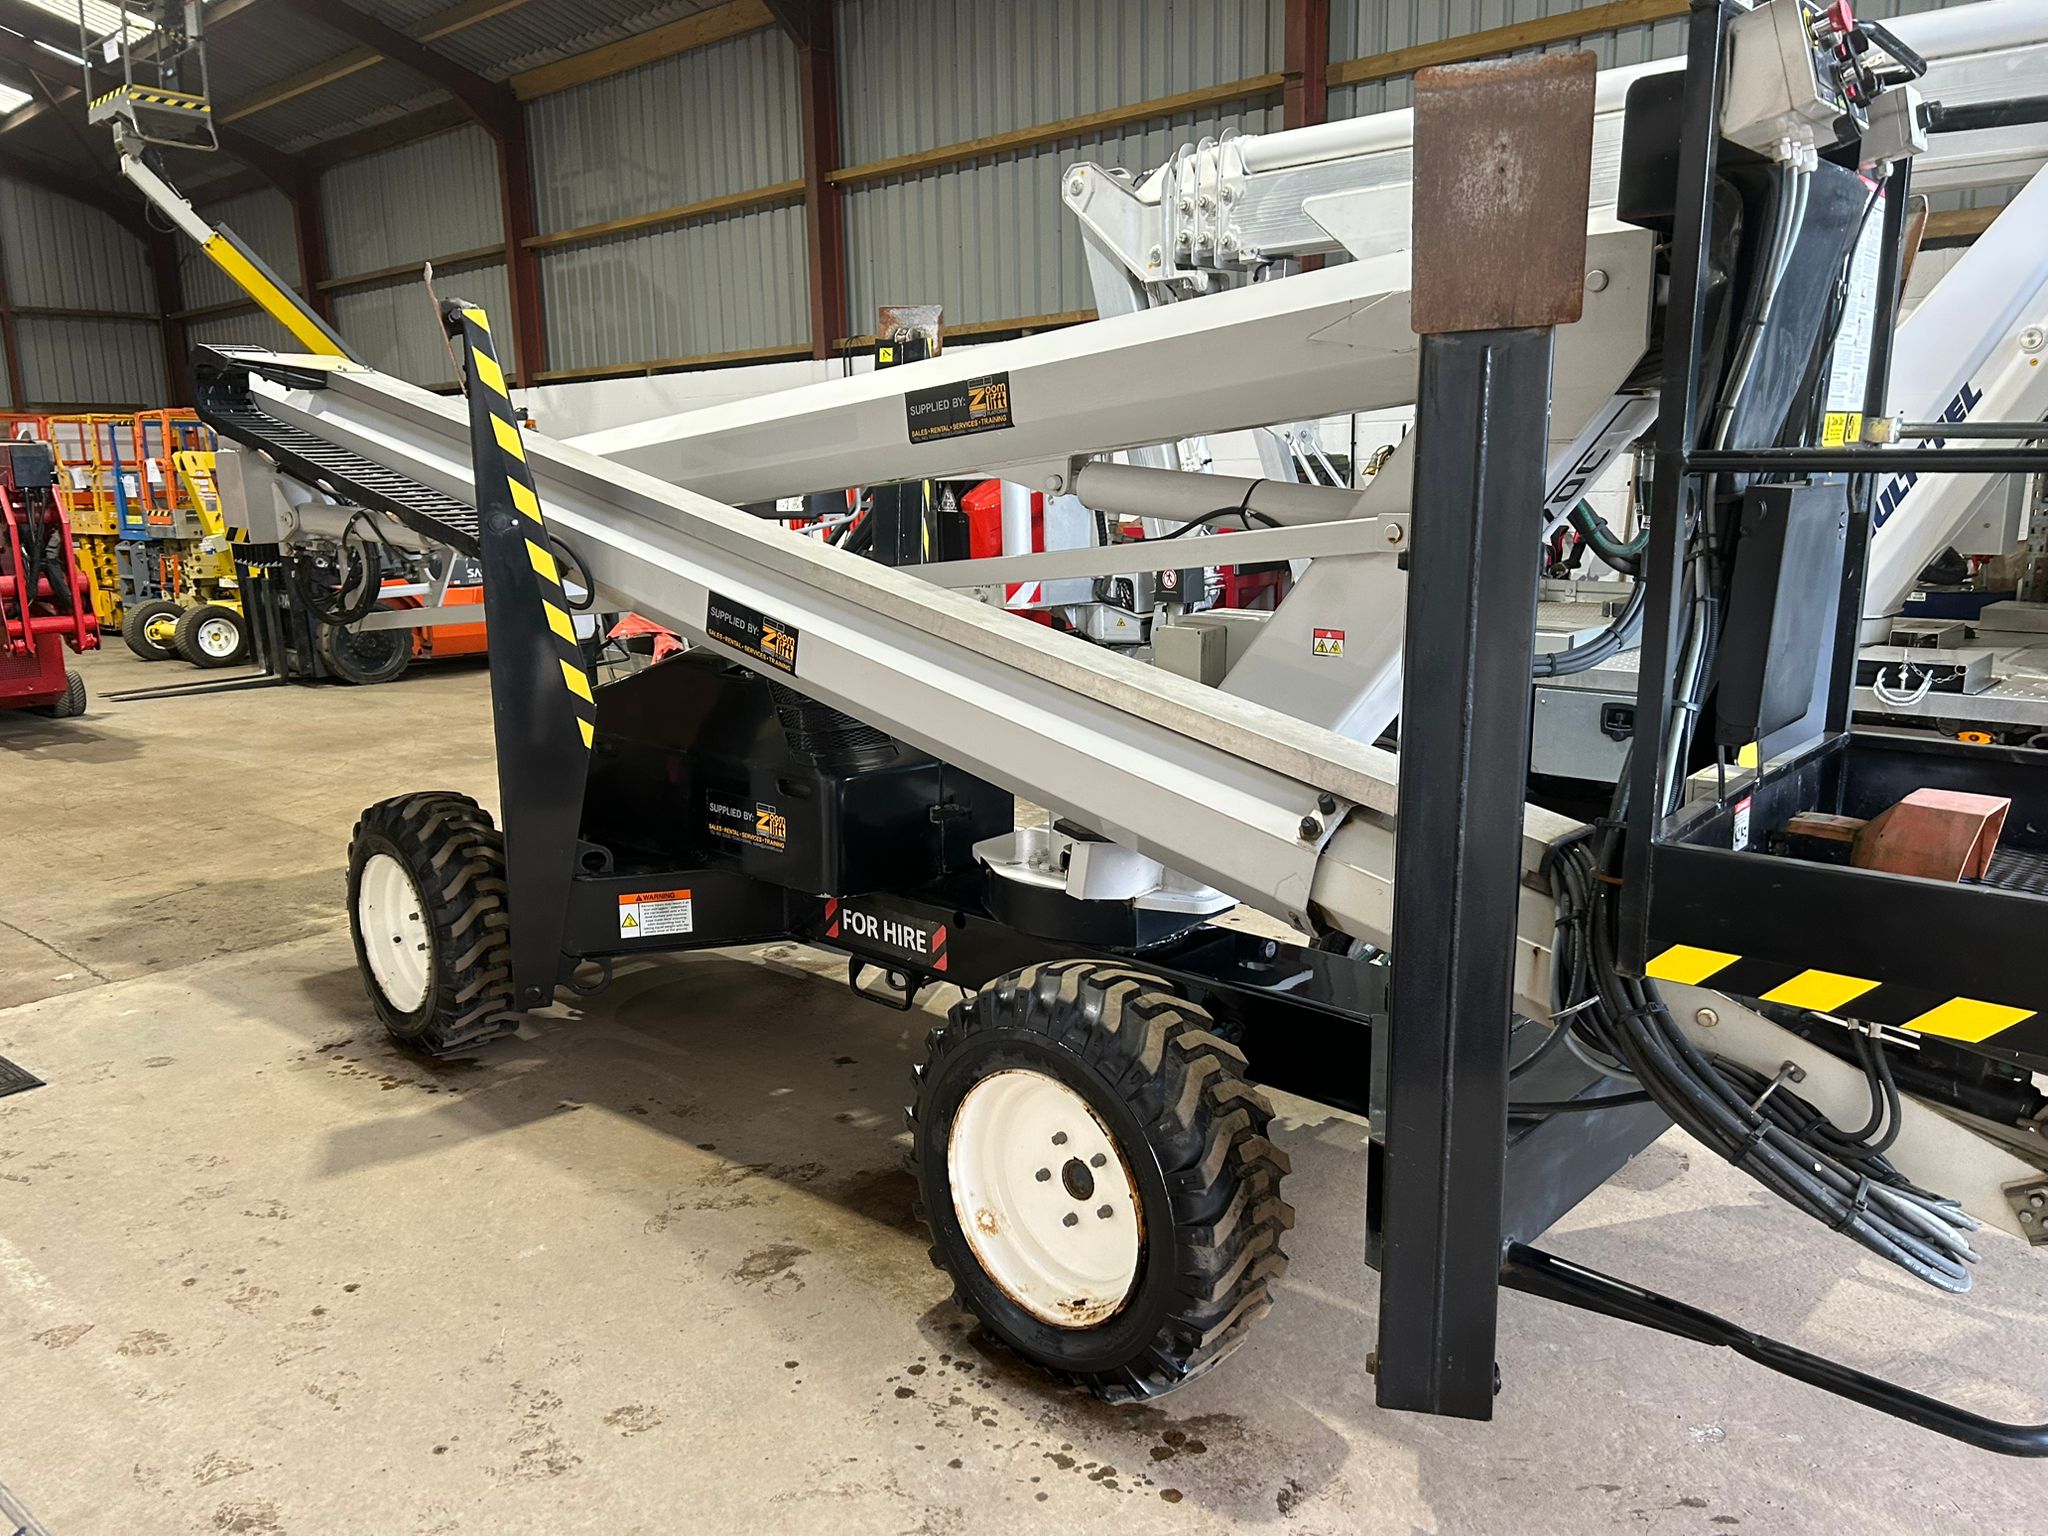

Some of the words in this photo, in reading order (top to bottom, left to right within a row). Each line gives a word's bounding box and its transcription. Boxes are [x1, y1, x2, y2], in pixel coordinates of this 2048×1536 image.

[910, 399, 950, 416] SUPPLIED
[952, 396, 966, 408] BY:
[986, 391, 1007, 411] lift
[710, 606, 745, 630] SUPPLIED
[747, 623, 760, 636] BY:
[776, 638, 794, 661] lift
[709, 802, 742, 819] SUPPLIED
[743, 811, 754, 822] BY:
[769, 820, 786, 839] lift
[643, 892, 675, 901] WARNING
[842, 908, 879, 940] FOR
[883, 919, 927, 953] HIRE
